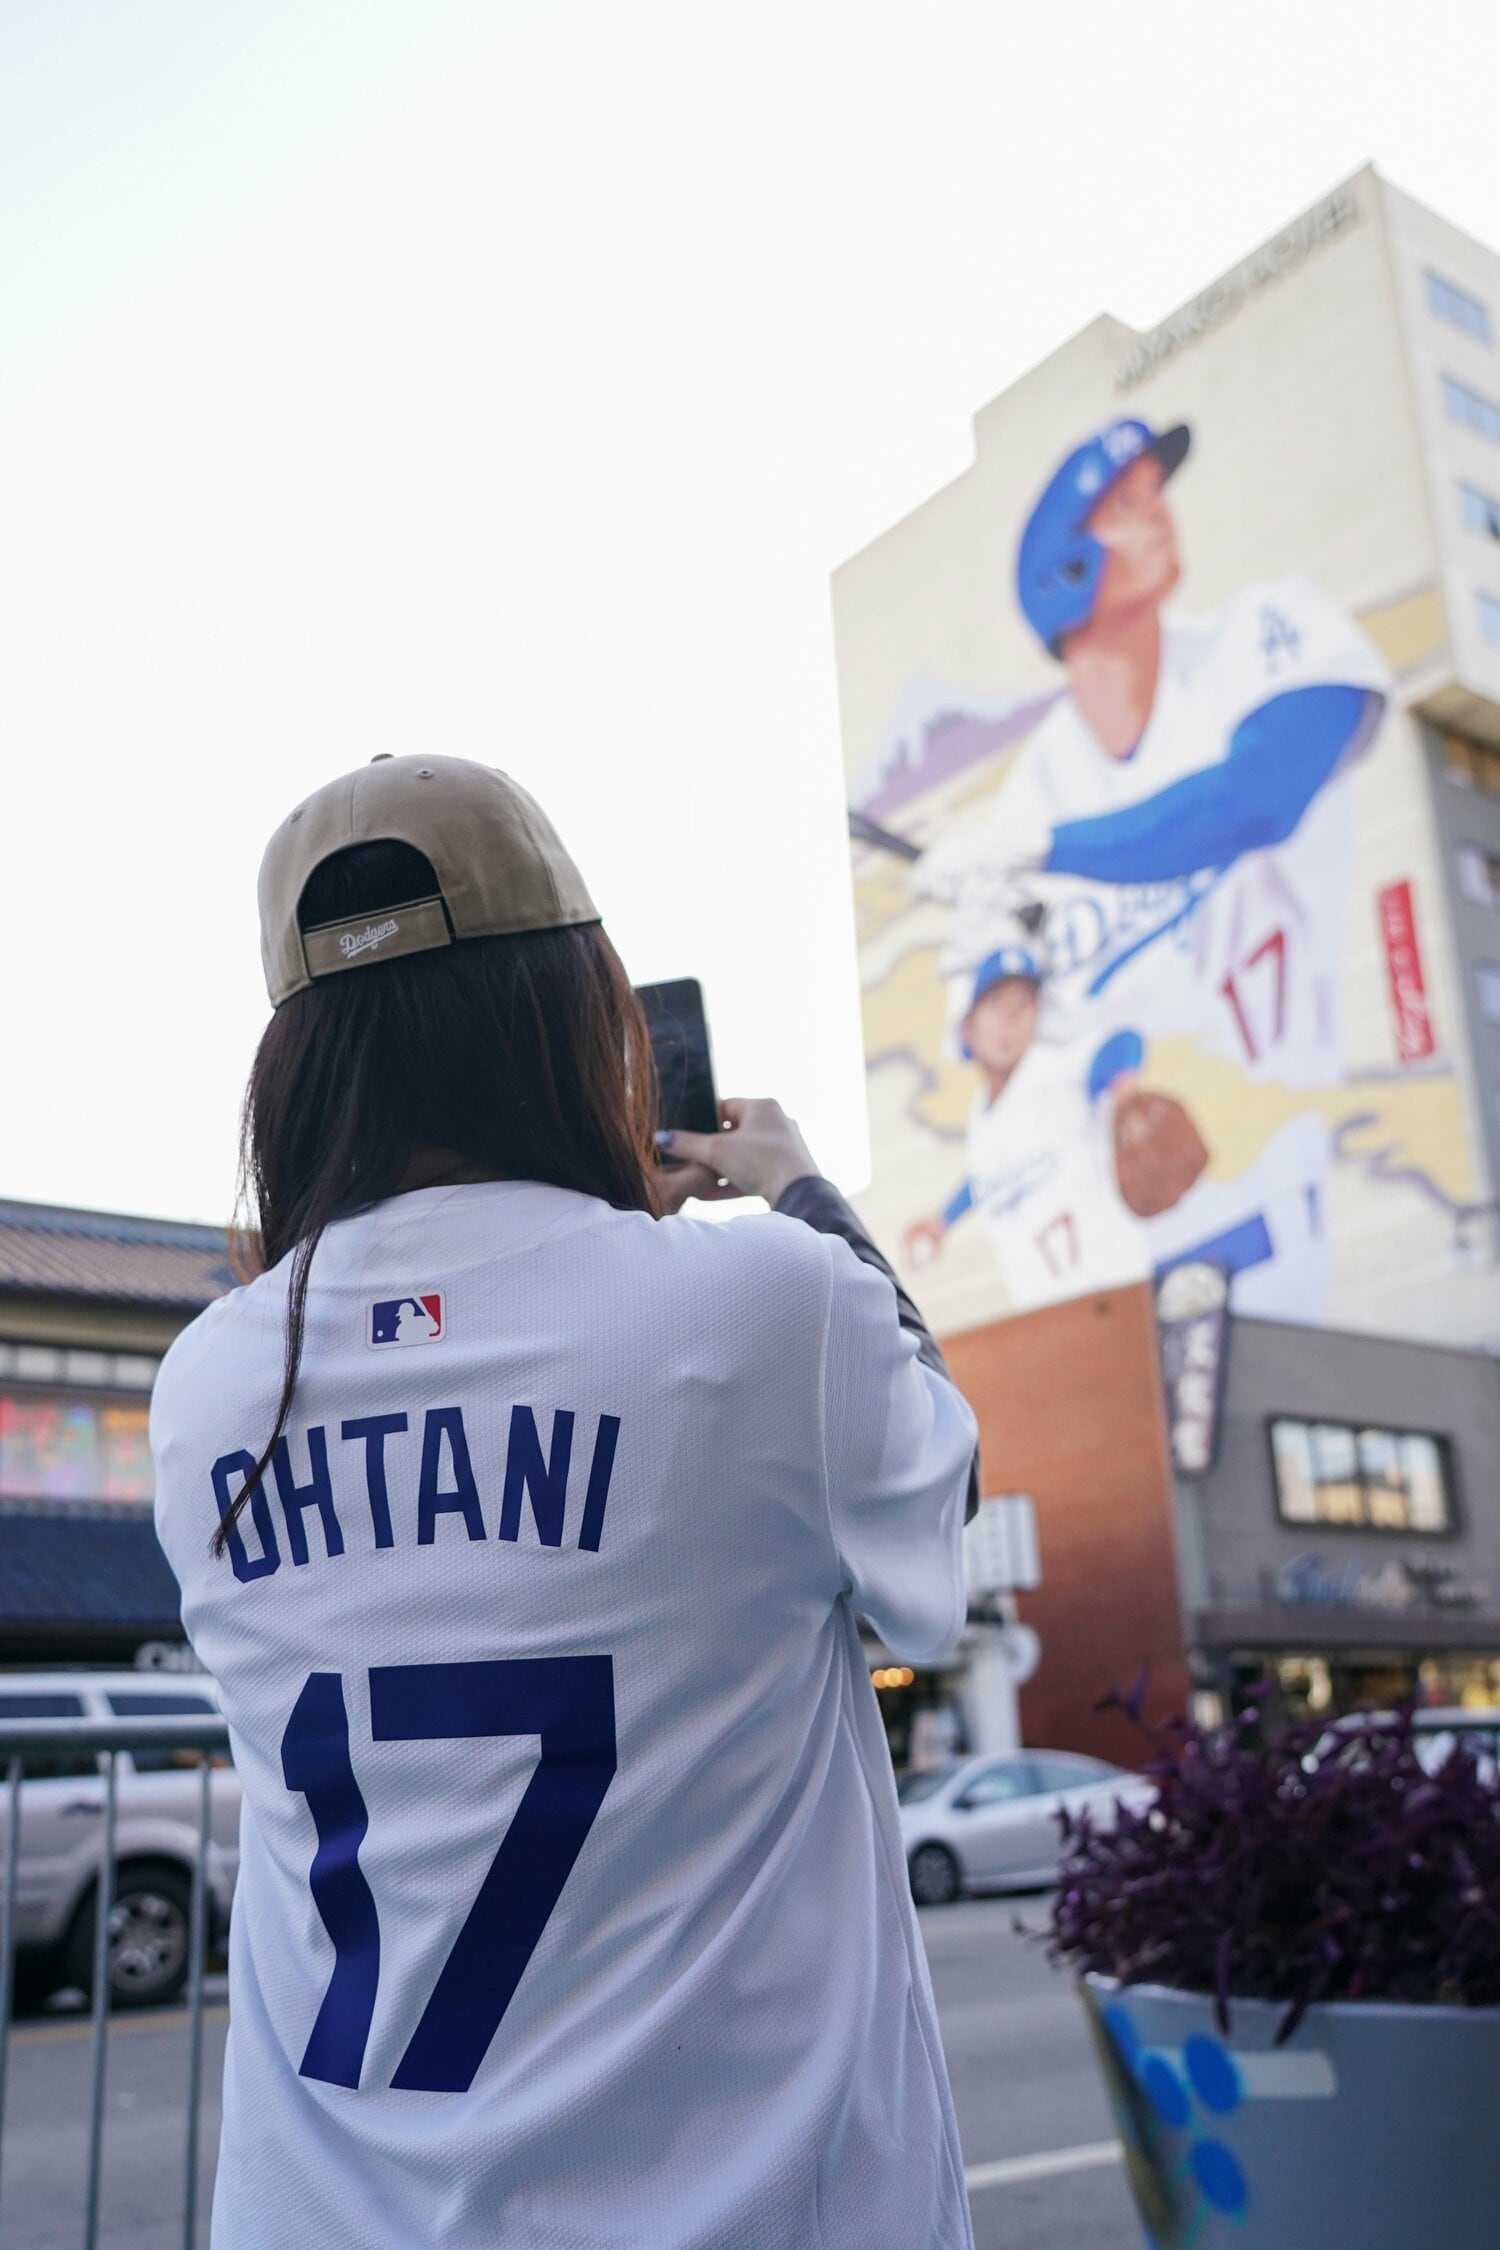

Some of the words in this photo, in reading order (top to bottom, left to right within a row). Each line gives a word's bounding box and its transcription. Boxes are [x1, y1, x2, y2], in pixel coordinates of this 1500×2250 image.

[339, 918, 399, 959] Dodgers
[1219, 927, 1287, 1062] 17
[211, 1405, 621, 1583] OHTANI
[281, 1654, 618, 2093] 17
